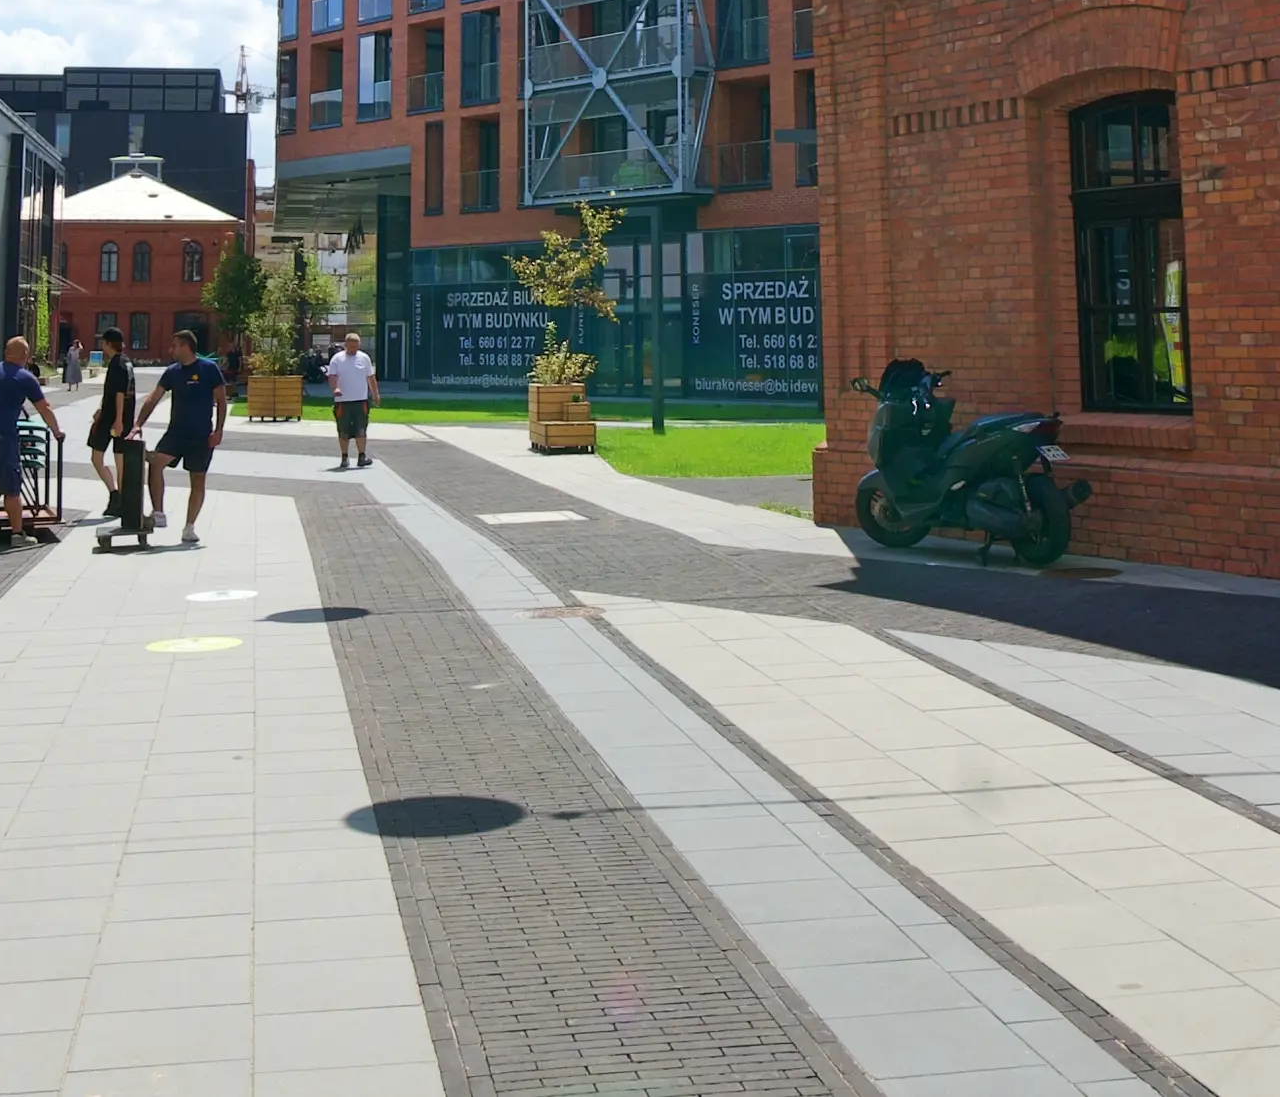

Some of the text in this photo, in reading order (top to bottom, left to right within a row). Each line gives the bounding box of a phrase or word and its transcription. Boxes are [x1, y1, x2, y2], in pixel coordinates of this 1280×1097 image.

[721, 275, 810, 301] SPRZEDAŻ
[447, 287, 509, 307] SPRZEDAŻ
[443, 312, 548, 329] W TYM BUDYNKU
[692, 283, 700, 344] KONESER
[719, 306, 817, 326] W TYM BUD
[459, 336, 536, 349] Tel. 660 61 22 77
[739, 334, 760, 349] Tel.
[763, 334, 785, 349] 660
[789, 334, 803, 349] 61
[459, 353, 474, 366] Tel.
[479, 353, 495, 366] 518
[497, 353, 509, 366] 68
[510, 353, 523, 366] 88
[739, 354, 760, 369] Tel.
[764, 354, 786, 369] 518
[789, 354, 804, 369] 68
[695, 377, 818, 395] biurakoneser@bbidev
